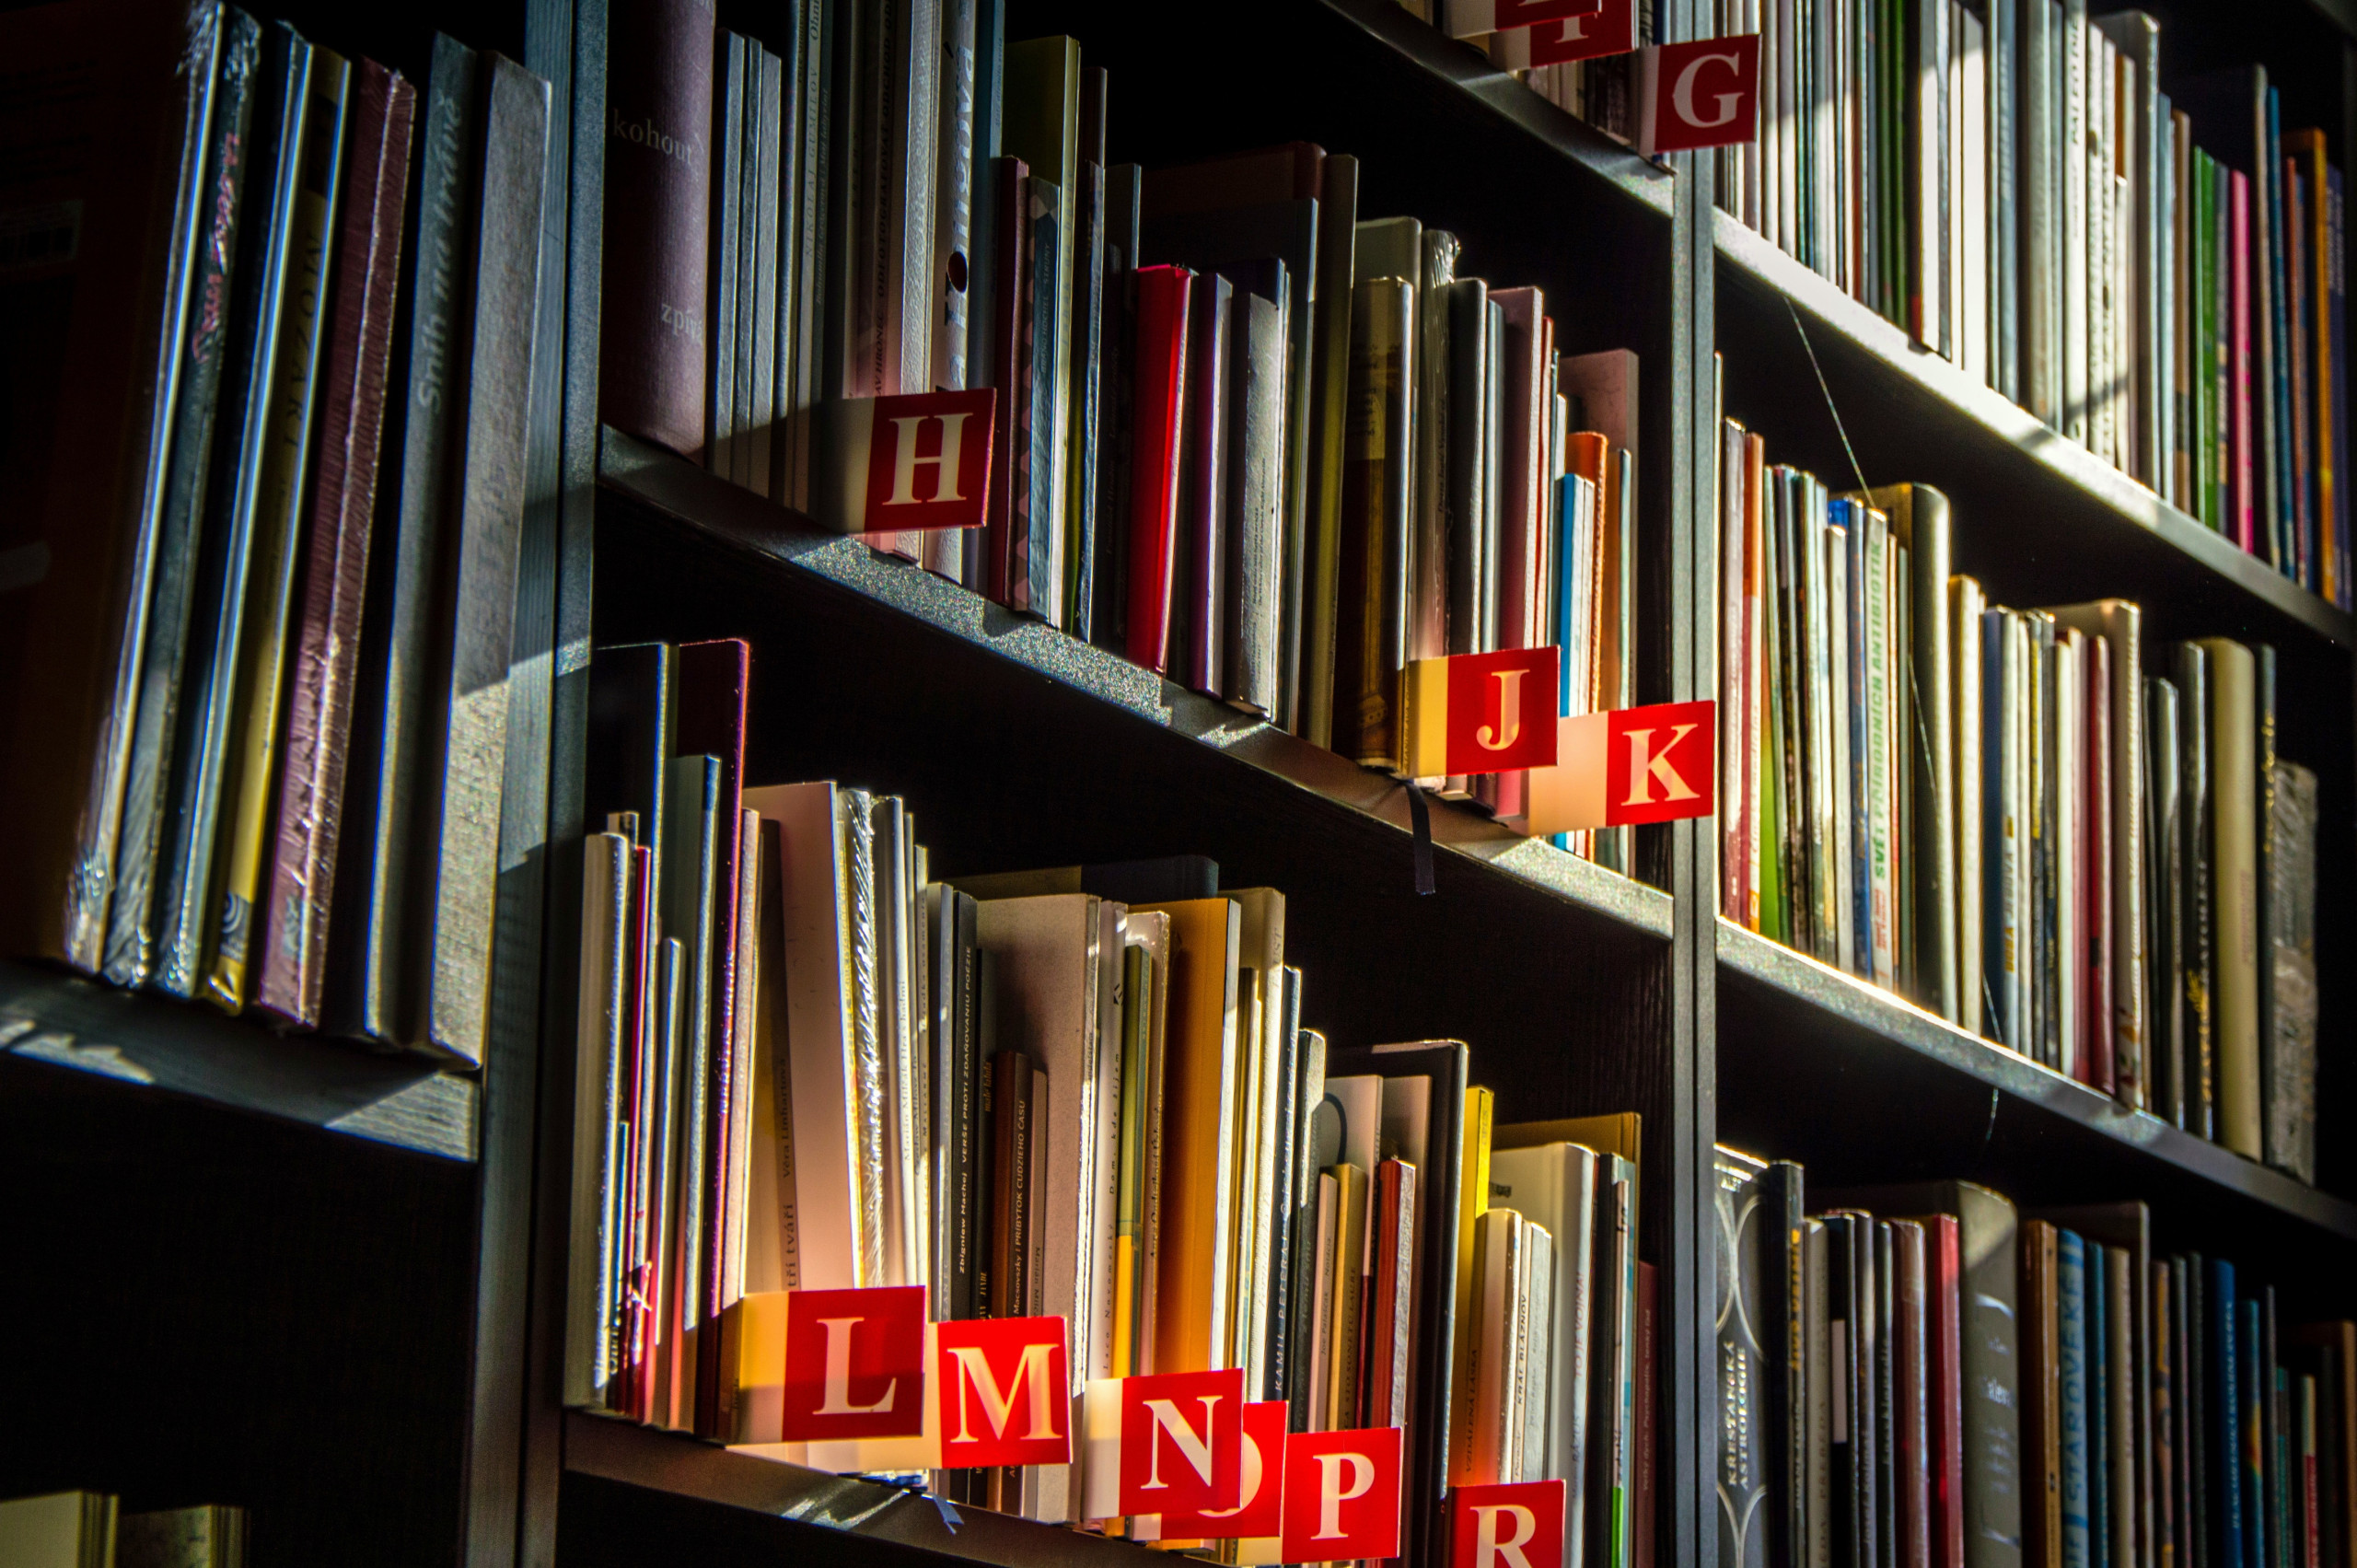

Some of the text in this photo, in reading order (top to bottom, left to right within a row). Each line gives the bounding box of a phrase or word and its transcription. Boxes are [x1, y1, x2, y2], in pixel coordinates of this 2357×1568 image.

[1672, 52, 1745, 128] G
[611, 108, 692, 167] kohout
[806, 168, 817, 258] NIKOLAJ
[875, 310, 885, 373] HRONEC
[881, 412, 974, 506] H
[1476, 669, 1530, 751] J
[1620, 724, 1701, 806] K
[962, 993, 970, 1078] ZDAŇOVANIU
[778, 1058, 796, 1287] tří tváří Věra Linhartová
[960, 1123, 969, 1163] VERŠE
[960, 1171, 969, 1214] Machej
[1012, 1098, 1026, 1315] Macsovszky PRÍBYTOK CUDZIEHO ČASU
[958, 1218, 967, 1273] Zbigniew
[812, 1317, 897, 1414] L
[946, 1343, 1062, 1443] M
[1275, 1332, 1284, 1392] KAMIL
[1574, 1356, 1583, 1378] TO
[1140, 1395, 1224, 1490] N
[1311, 1452, 1376, 1540] P
[1469, 1504, 1537, 1568] R
